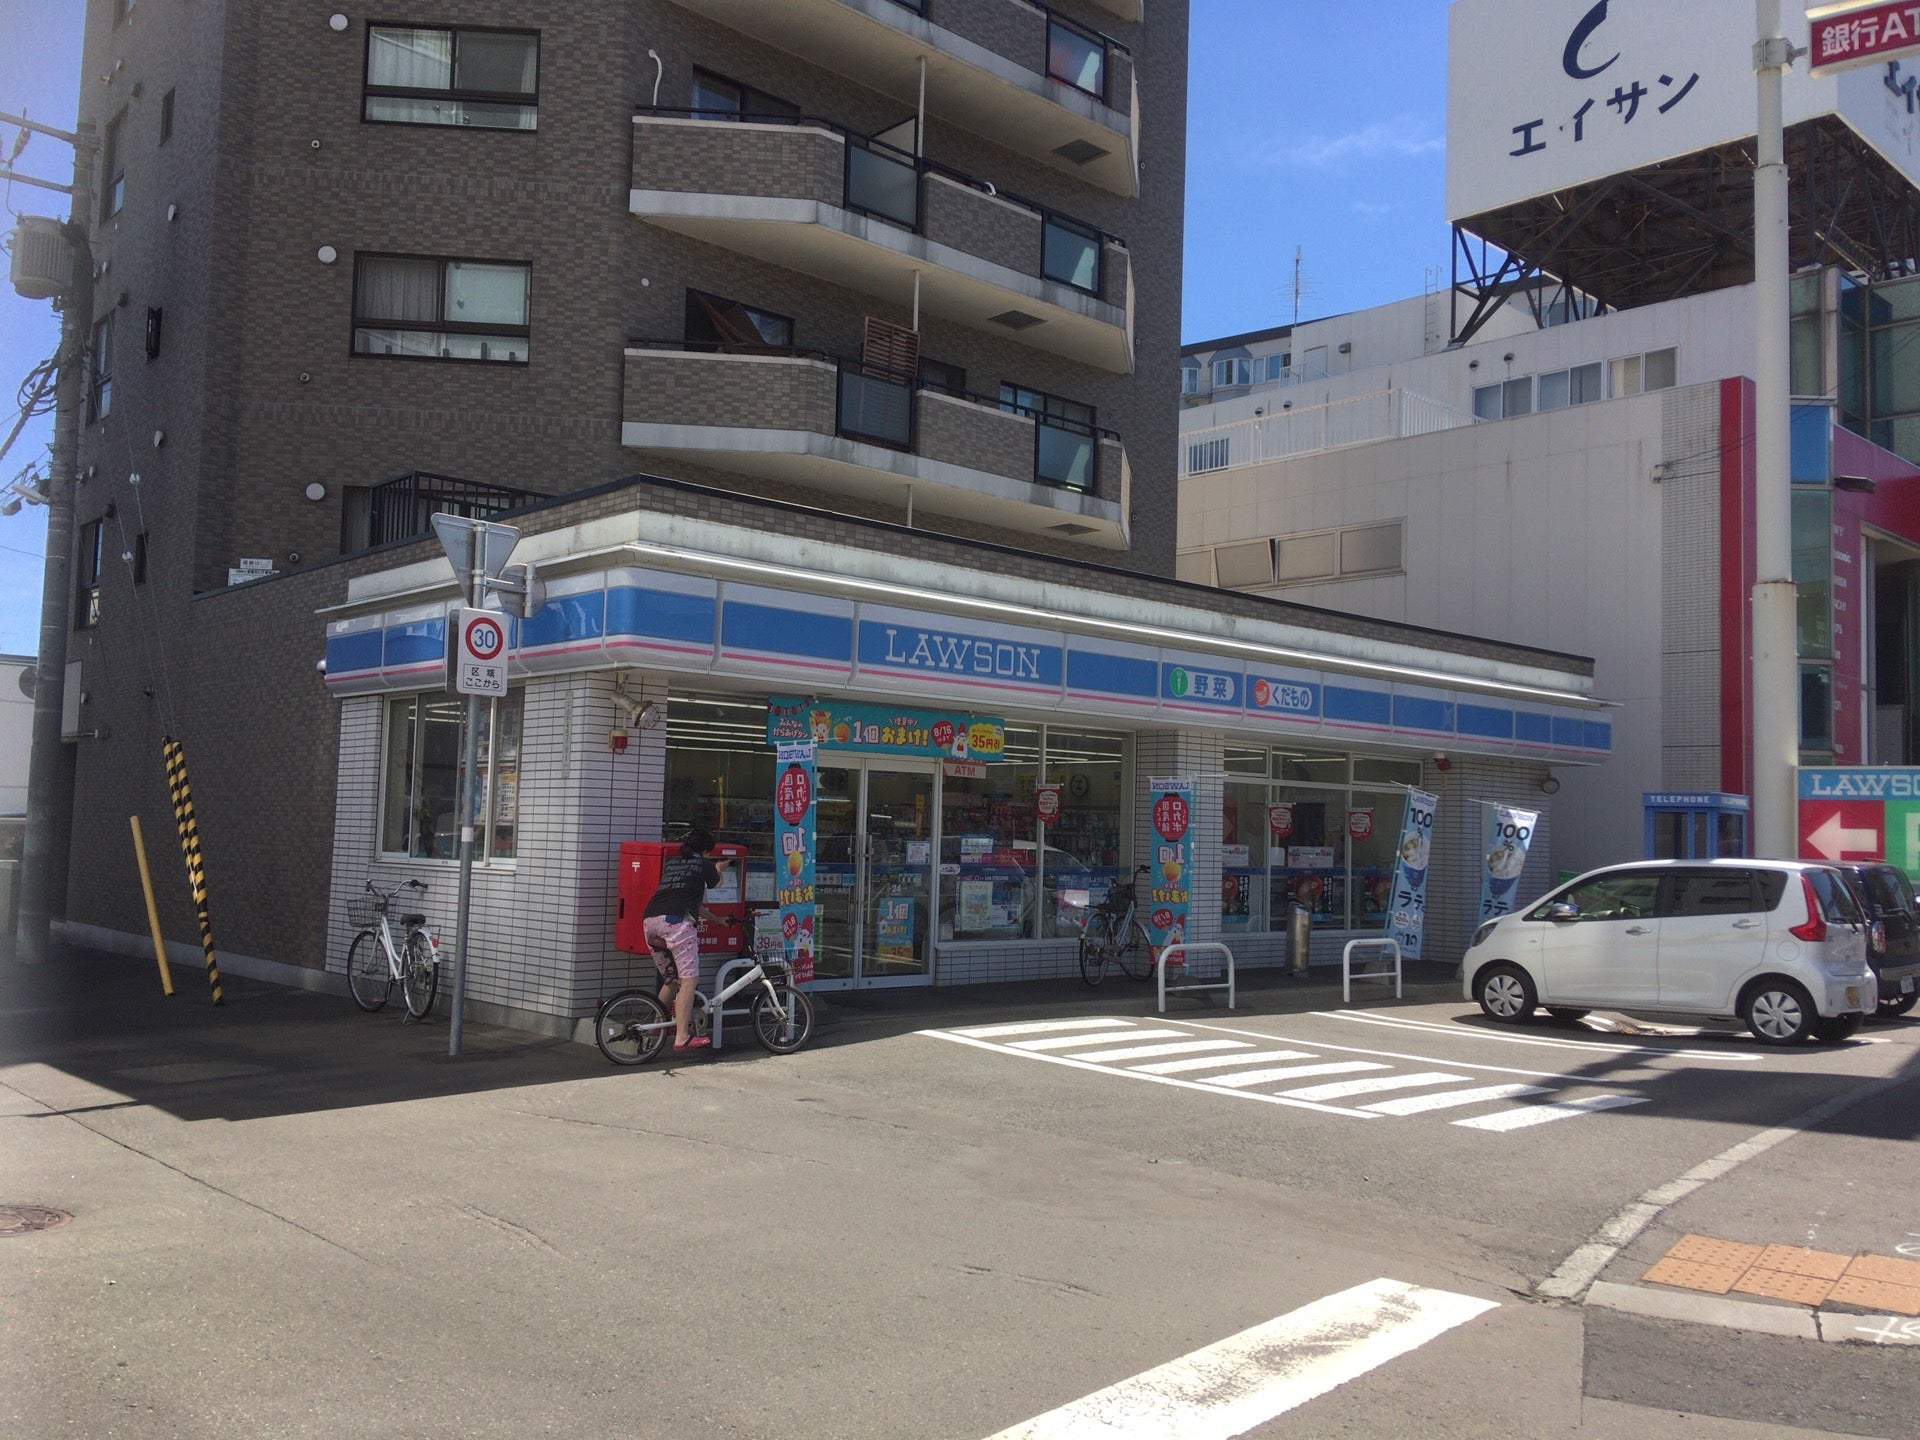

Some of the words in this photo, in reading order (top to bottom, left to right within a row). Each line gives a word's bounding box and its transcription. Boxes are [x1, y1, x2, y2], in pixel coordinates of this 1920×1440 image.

[1509, 72, 1700, 157] エイサン
[474, 628, 495, 649] 30
[885, 629, 1041, 679] LAWSON
[465, 677, 500, 689] ここから
[1194, 674, 1227, 698] 野菜
[1272, 685, 1309, 710] くだもの
[933, 724, 952, 737] 8/16
[953, 765, 976, 777] ATM
[1650, 795, 1711, 803] TELEPHONE
